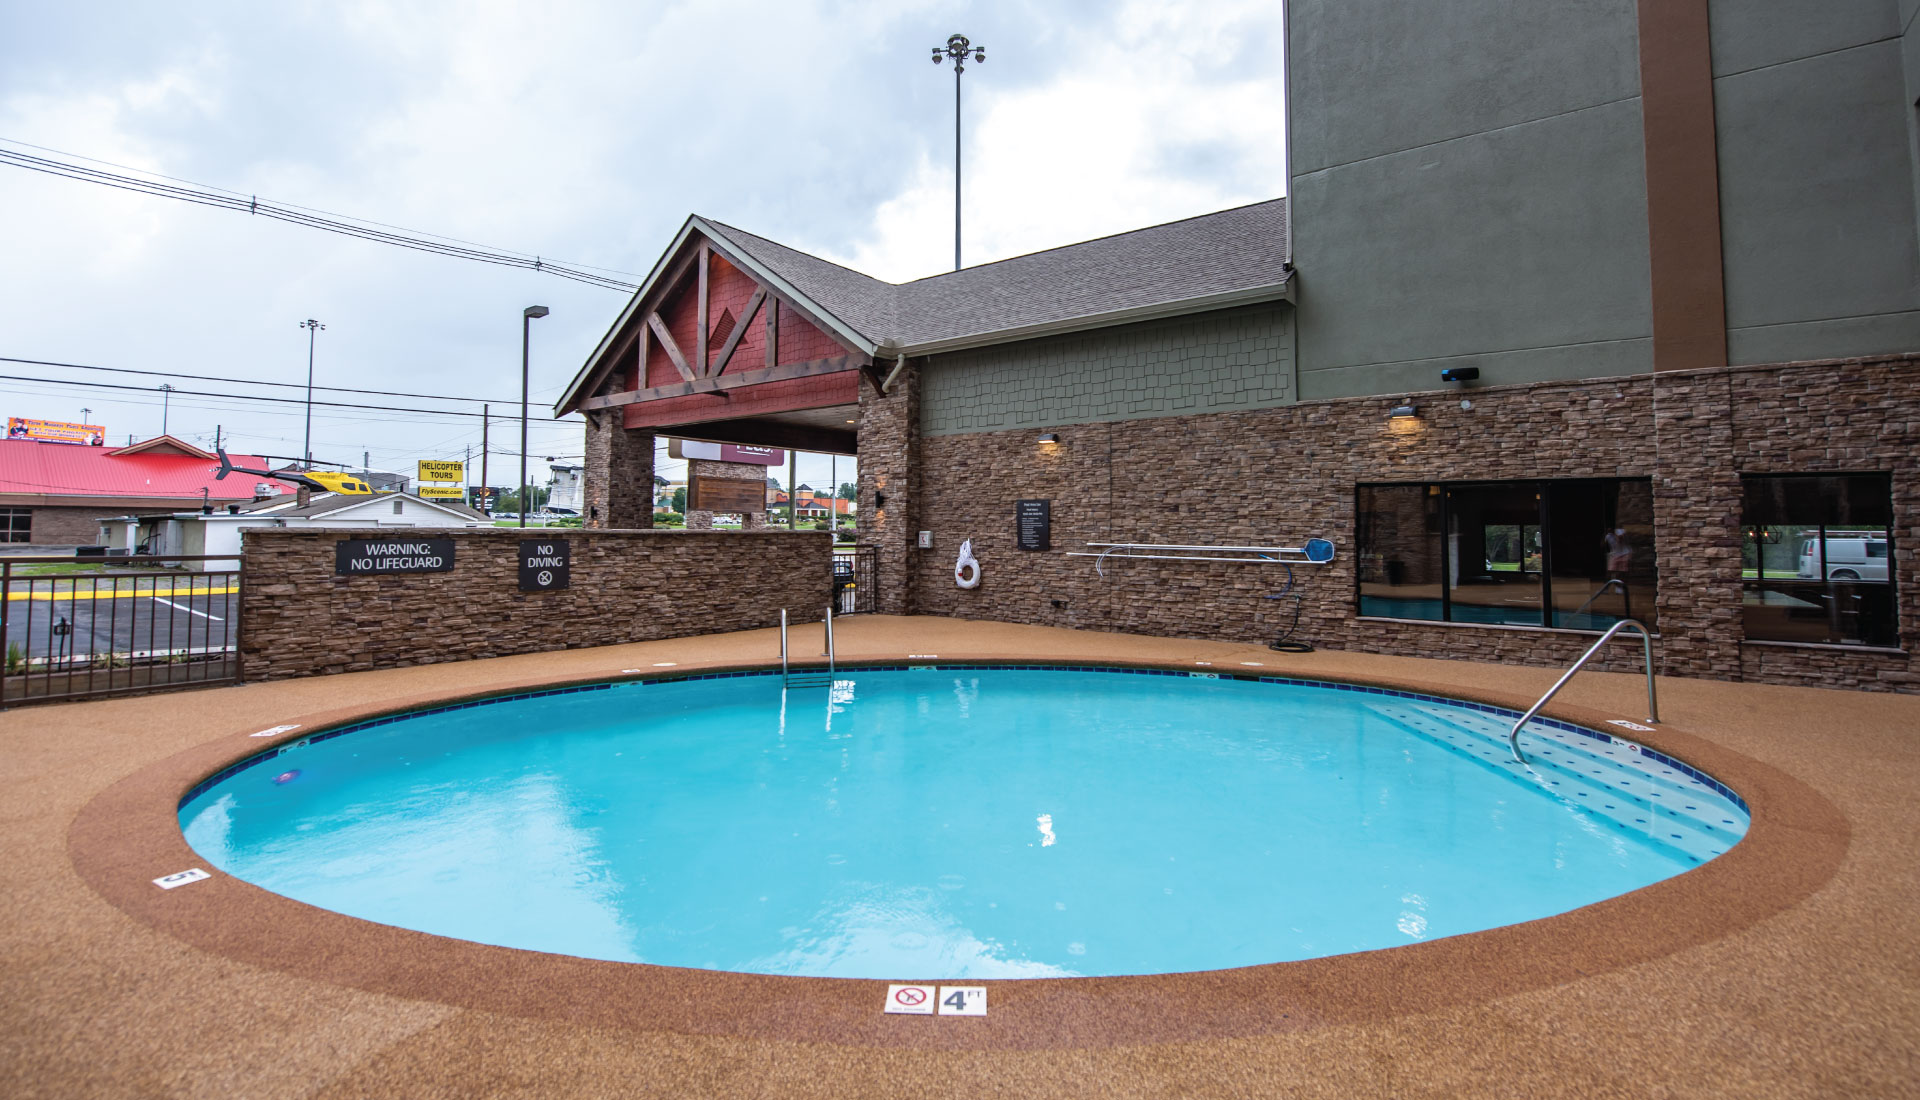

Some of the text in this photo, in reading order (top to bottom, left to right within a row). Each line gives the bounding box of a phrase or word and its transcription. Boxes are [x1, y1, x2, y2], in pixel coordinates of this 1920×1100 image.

[421, 462, 462, 471] HELICOPTER
[366, 543, 431, 556] WARNING:
[537, 545, 553, 555] NO
[351, 556, 442, 570] NO LIFEGUARD
[527, 556, 563, 568] DIVING
